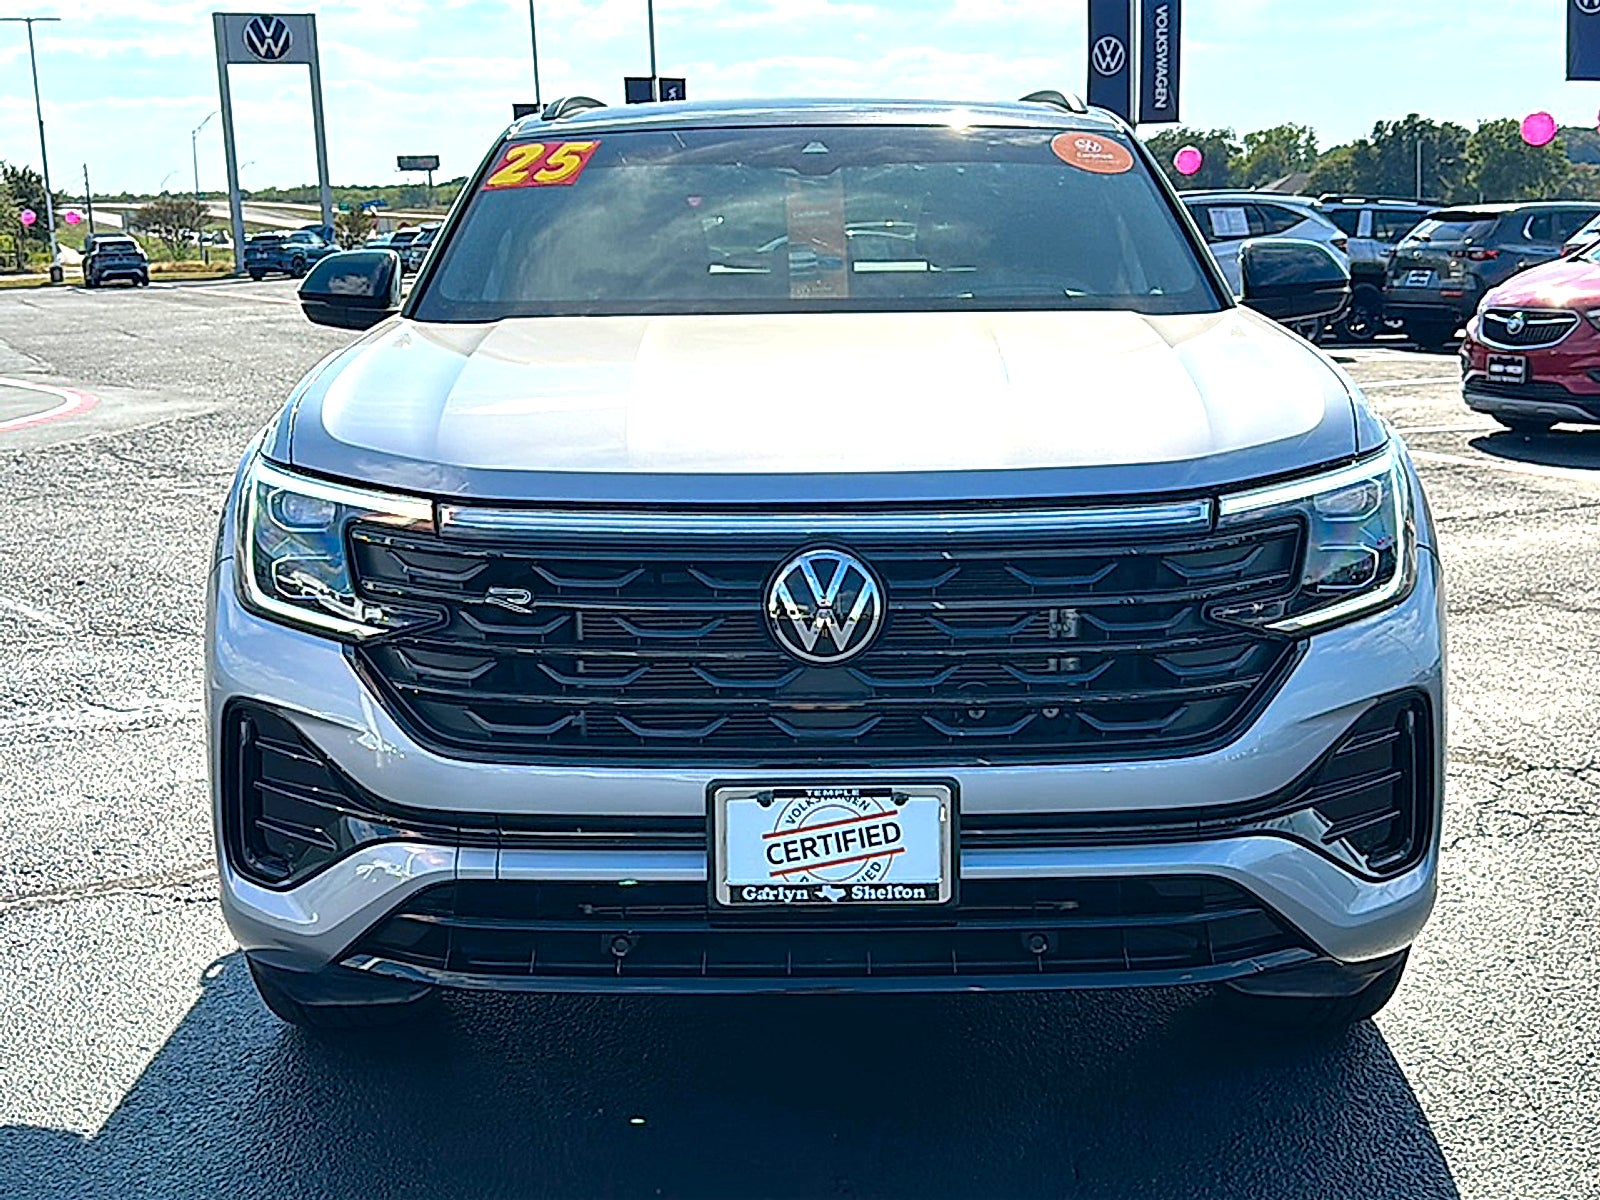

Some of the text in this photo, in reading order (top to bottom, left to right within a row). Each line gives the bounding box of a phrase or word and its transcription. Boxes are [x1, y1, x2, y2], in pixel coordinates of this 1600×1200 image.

[1154, 4, 1169, 108] VOLKSWAGEN
[487, 142, 594, 185] 25
[805, 789, 860, 797] TEMPLE
[766, 821, 901, 865] CERTIFIED
[741, 885, 926, 904] Garlyn Shelton
